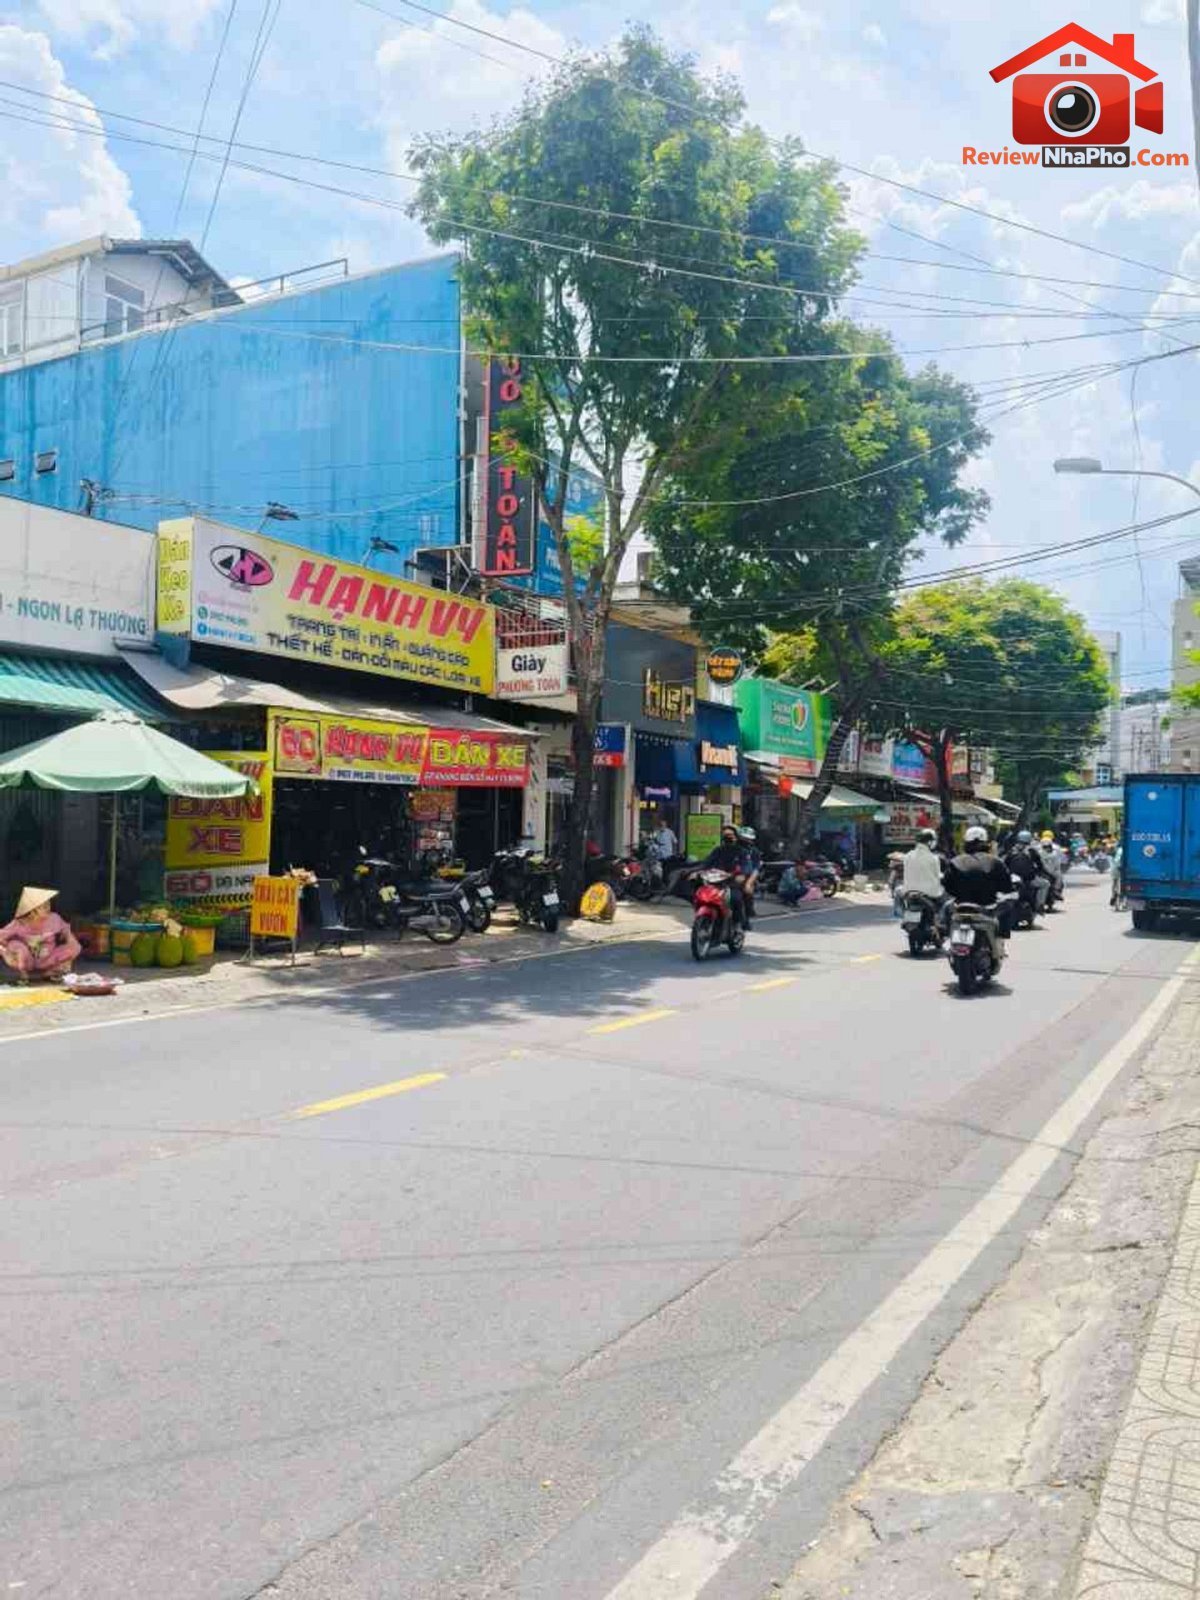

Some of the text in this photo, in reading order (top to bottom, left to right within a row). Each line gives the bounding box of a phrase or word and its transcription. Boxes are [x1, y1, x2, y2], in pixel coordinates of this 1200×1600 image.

[18, 597, 61, 621] NGON
[288, 559, 427, 621] HẠNH
[428, 601, 487, 644] VY
[286, 613, 336, 637] TRANG
[511, 654, 547, 673] Giày
